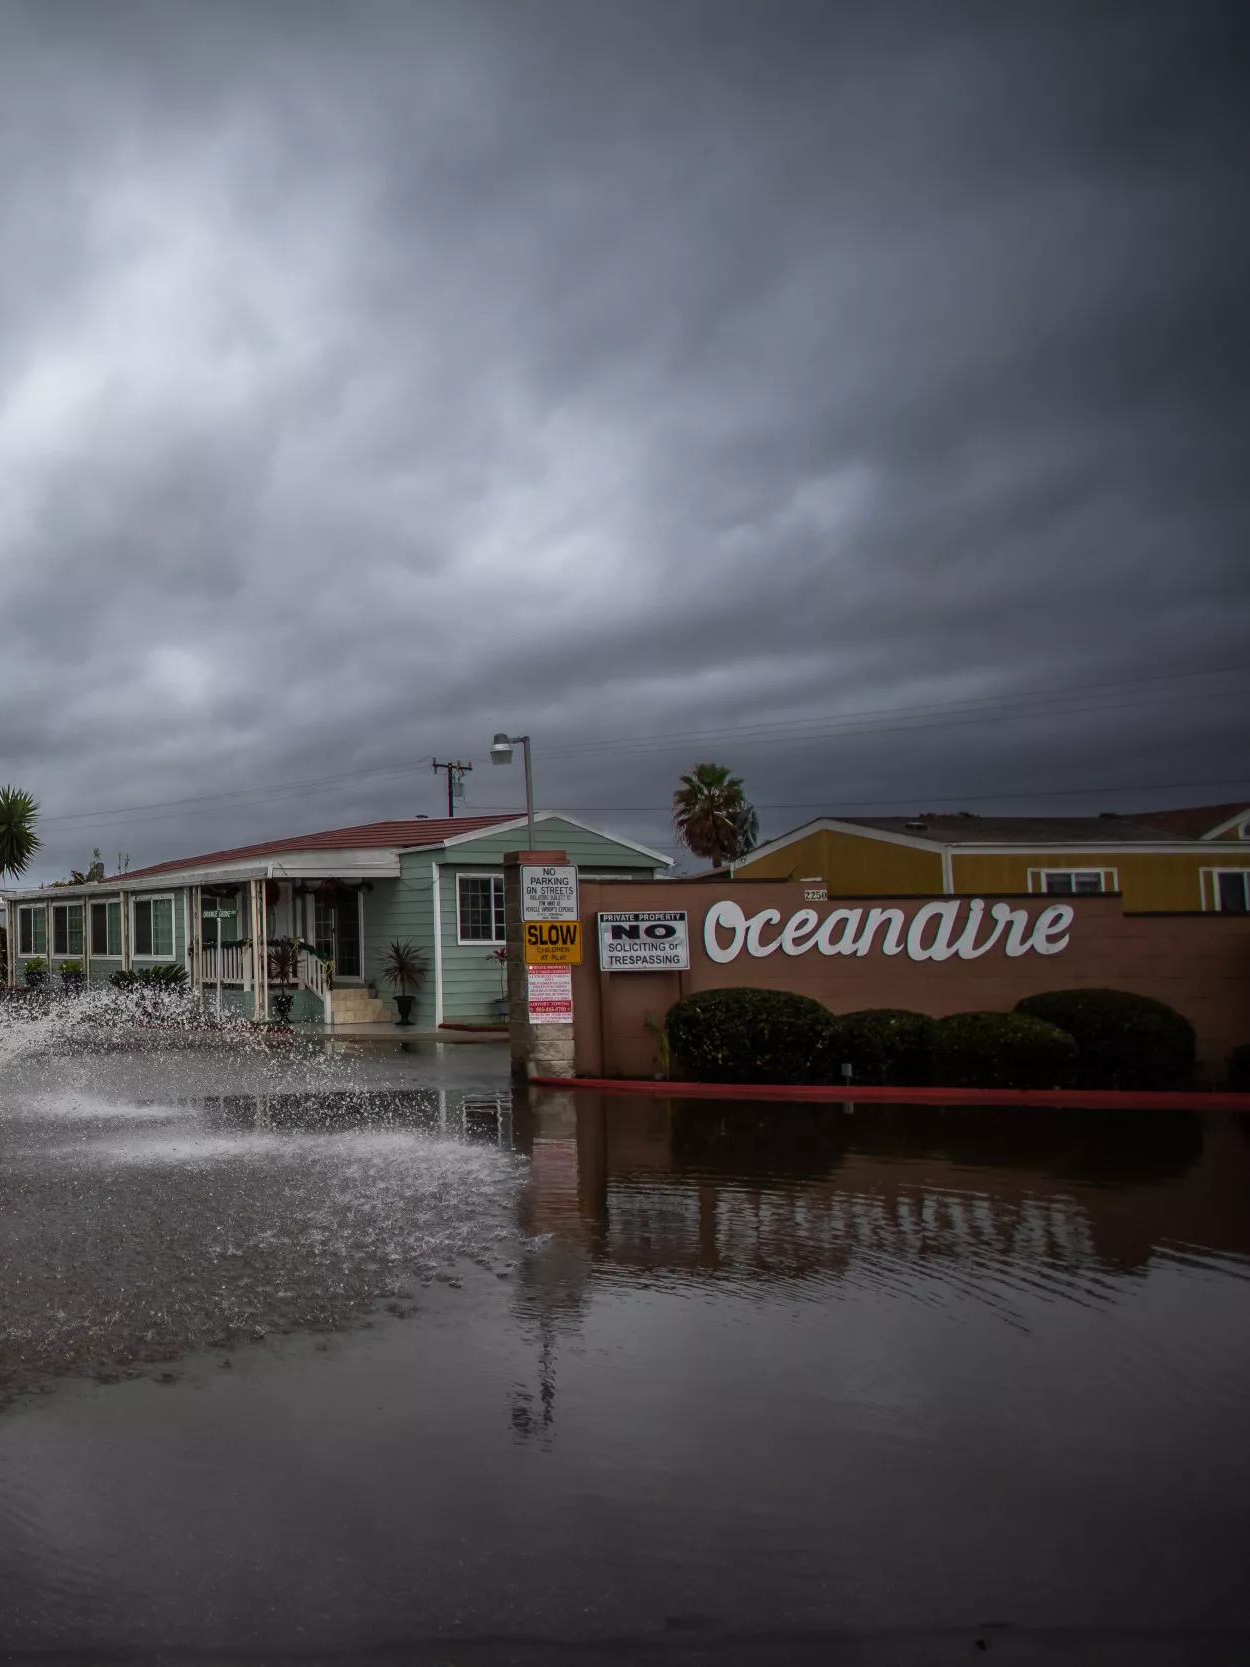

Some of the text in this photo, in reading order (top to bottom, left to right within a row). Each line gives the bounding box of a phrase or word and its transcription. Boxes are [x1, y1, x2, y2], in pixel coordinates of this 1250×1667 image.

[543, 868, 556, 876] NO
[530, 877, 569, 885] PARKING
[526, 886, 574, 894] ON STREETS
[805, 891, 827, 900] 2250
[639, 913, 681, 921] PROPERTY
[528, 924, 577, 945] SLOW
[611, 923, 677, 940] NO
[608, 942, 679, 952] SOLICITING or
[608, 954, 680, 965] TRESPASSING
